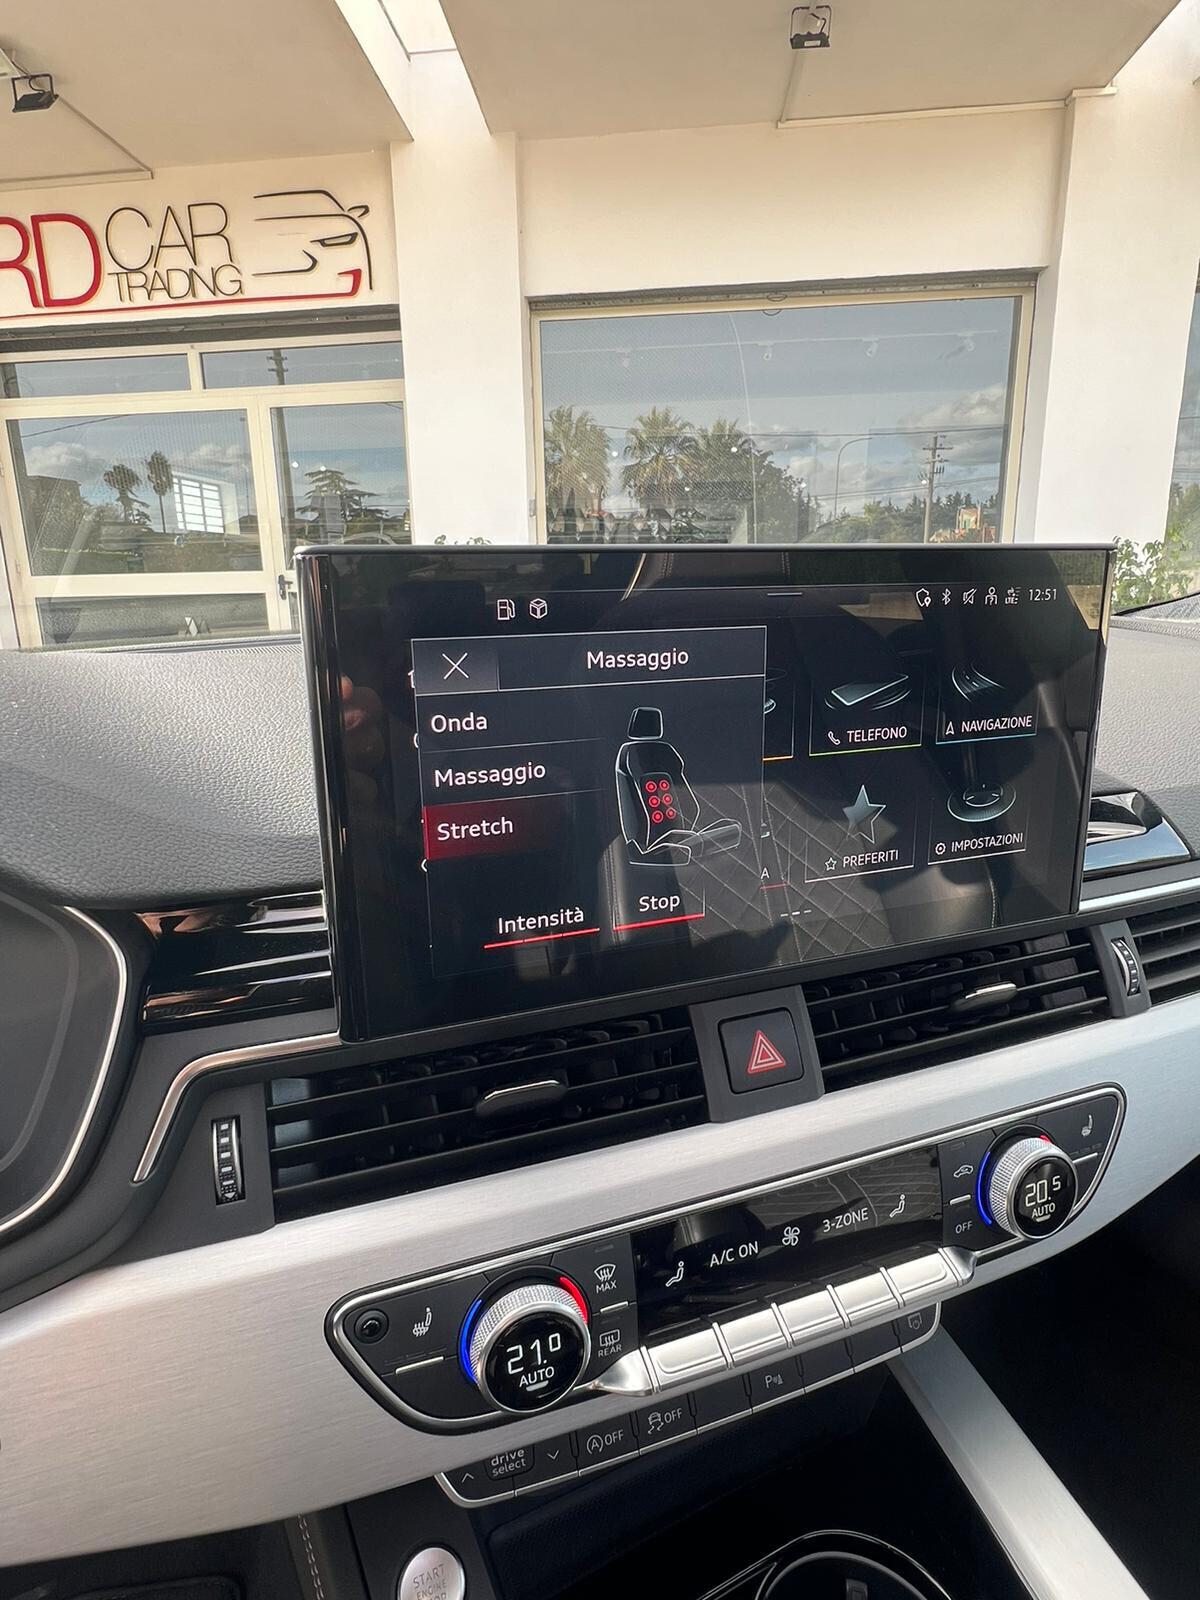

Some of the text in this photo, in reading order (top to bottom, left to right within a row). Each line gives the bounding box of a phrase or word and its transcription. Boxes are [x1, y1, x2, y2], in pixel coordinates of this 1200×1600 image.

[106, 202, 233, 271] CAR
[1028, 588, 1057, 601] 12:51
[586, 648, 689, 671] Massaggio
[430, 711, 488, 733] Onda
[961, 716, 1033, 734] NAVIGAZIONE
[846, 726, 908, 743] TELEFONO
[434, 761, 546, 788] Massaggio
[437, 816, 514, 840] Stretch
[951, 832, 1024, 853] IMPOSTAZIONI
[842, 849, 899, 868] PREFERITI
[638, 893, 681, 914] Stop
[498, 906, 585, 934] Intensità
[1025, 1175, 1061, 1207] 20.5
[822, 1207, 869, 1233] 3-ZONE
[1031, 1202, 1056, 1218] AUTO
[955, 1221, 973, 1234] OFF
[709, 1241, 759, 1267] A/C ON
[595, 1280, 617, 1294] MAX
[506, 1332, 562, 1375] 21.0
[598, 1344, 622, 1358] REAR
[518, 1366, 555, 1387] AUTO
[664, 1408, 683, 1424] OFF
[604, 1429, 625, 1446] OFF
[490, 1448, 526, 1467] drive
[491, 1458, 527, 1477] select
[412, 1562, 446, 1590] START
